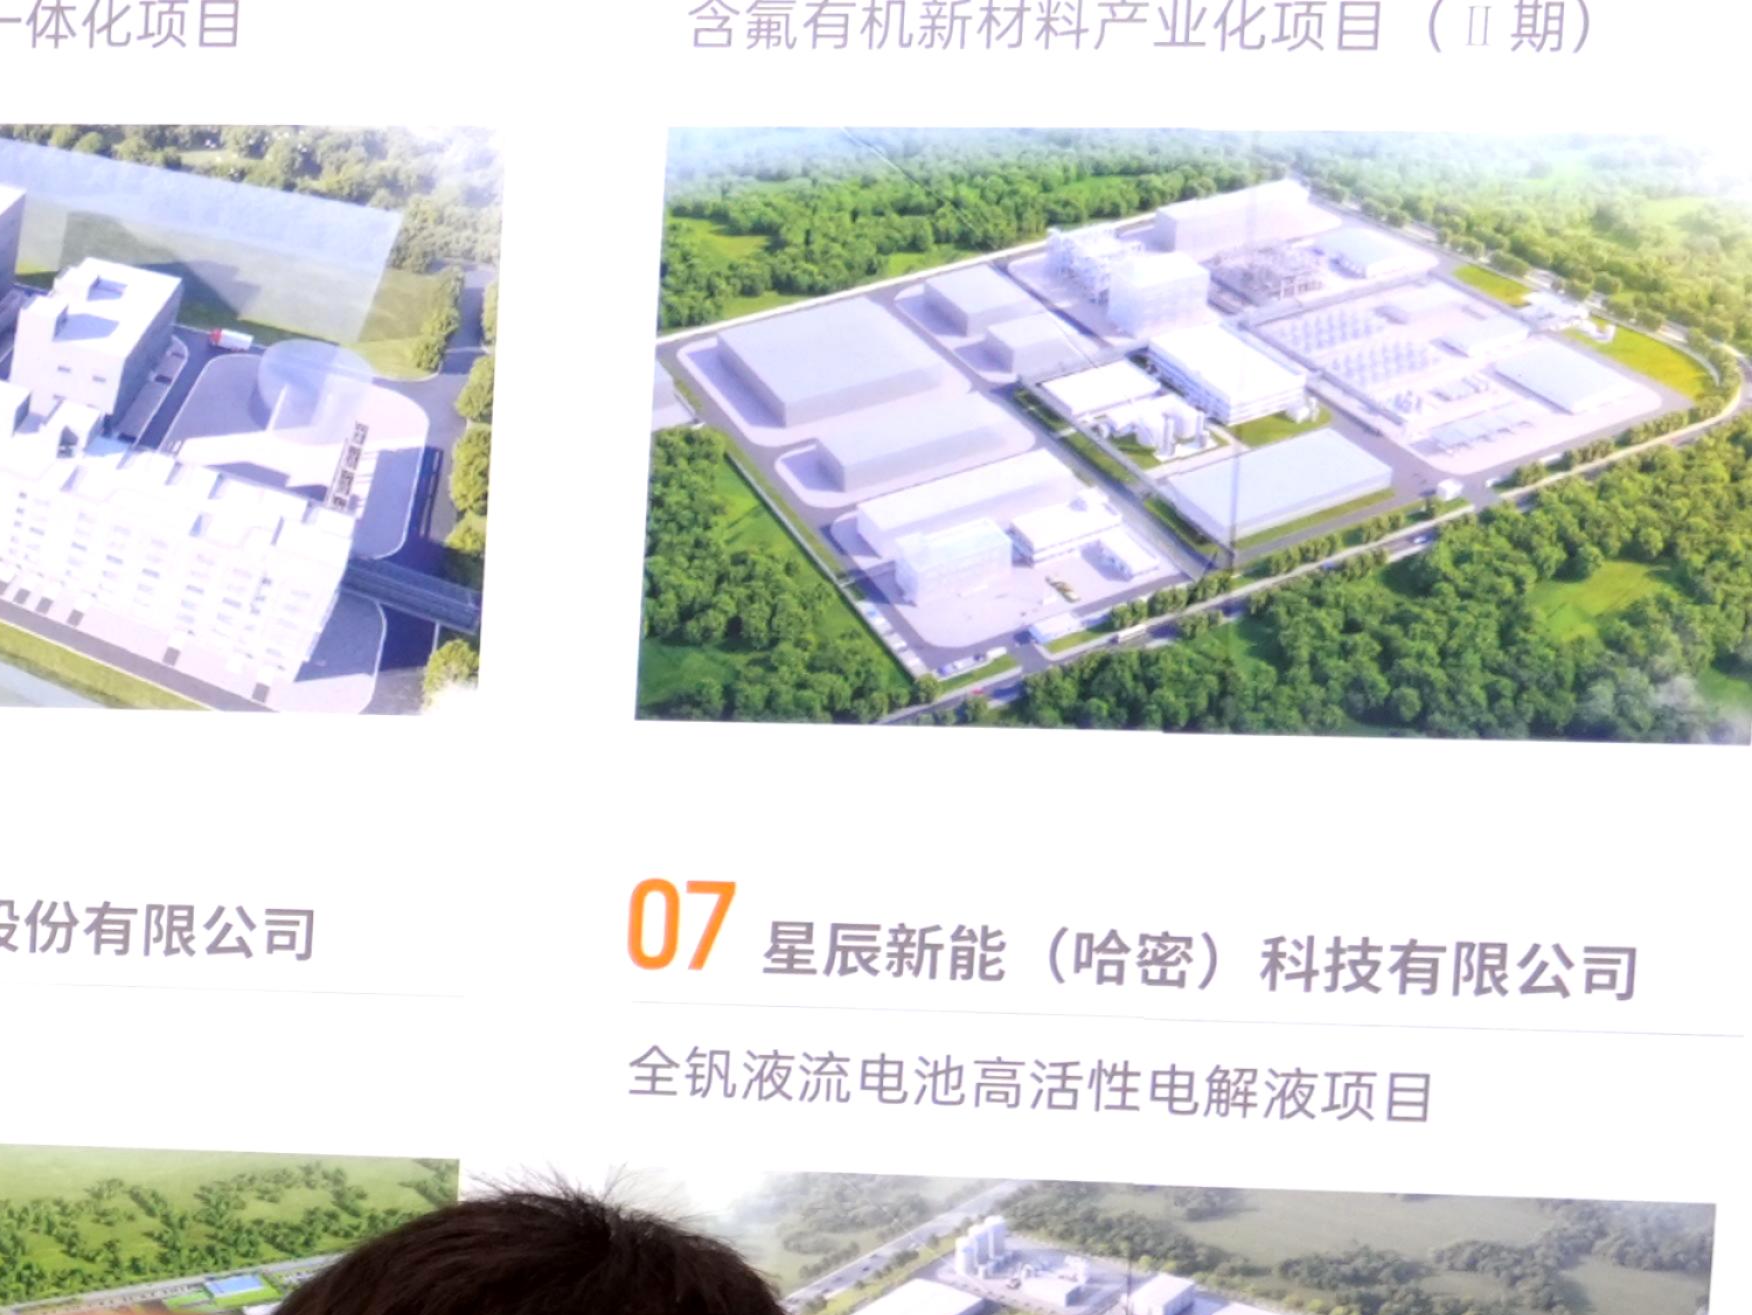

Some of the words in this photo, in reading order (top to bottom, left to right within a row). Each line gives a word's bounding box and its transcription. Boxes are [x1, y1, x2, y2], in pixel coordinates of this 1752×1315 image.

[628, 879, 738, 972] 07
[763, 921, 1638, 1003] 星辰新能（哈密）科技有限公司
[629, 1045, 1432, 1124] 全钒液流电池高活性电解液项目
